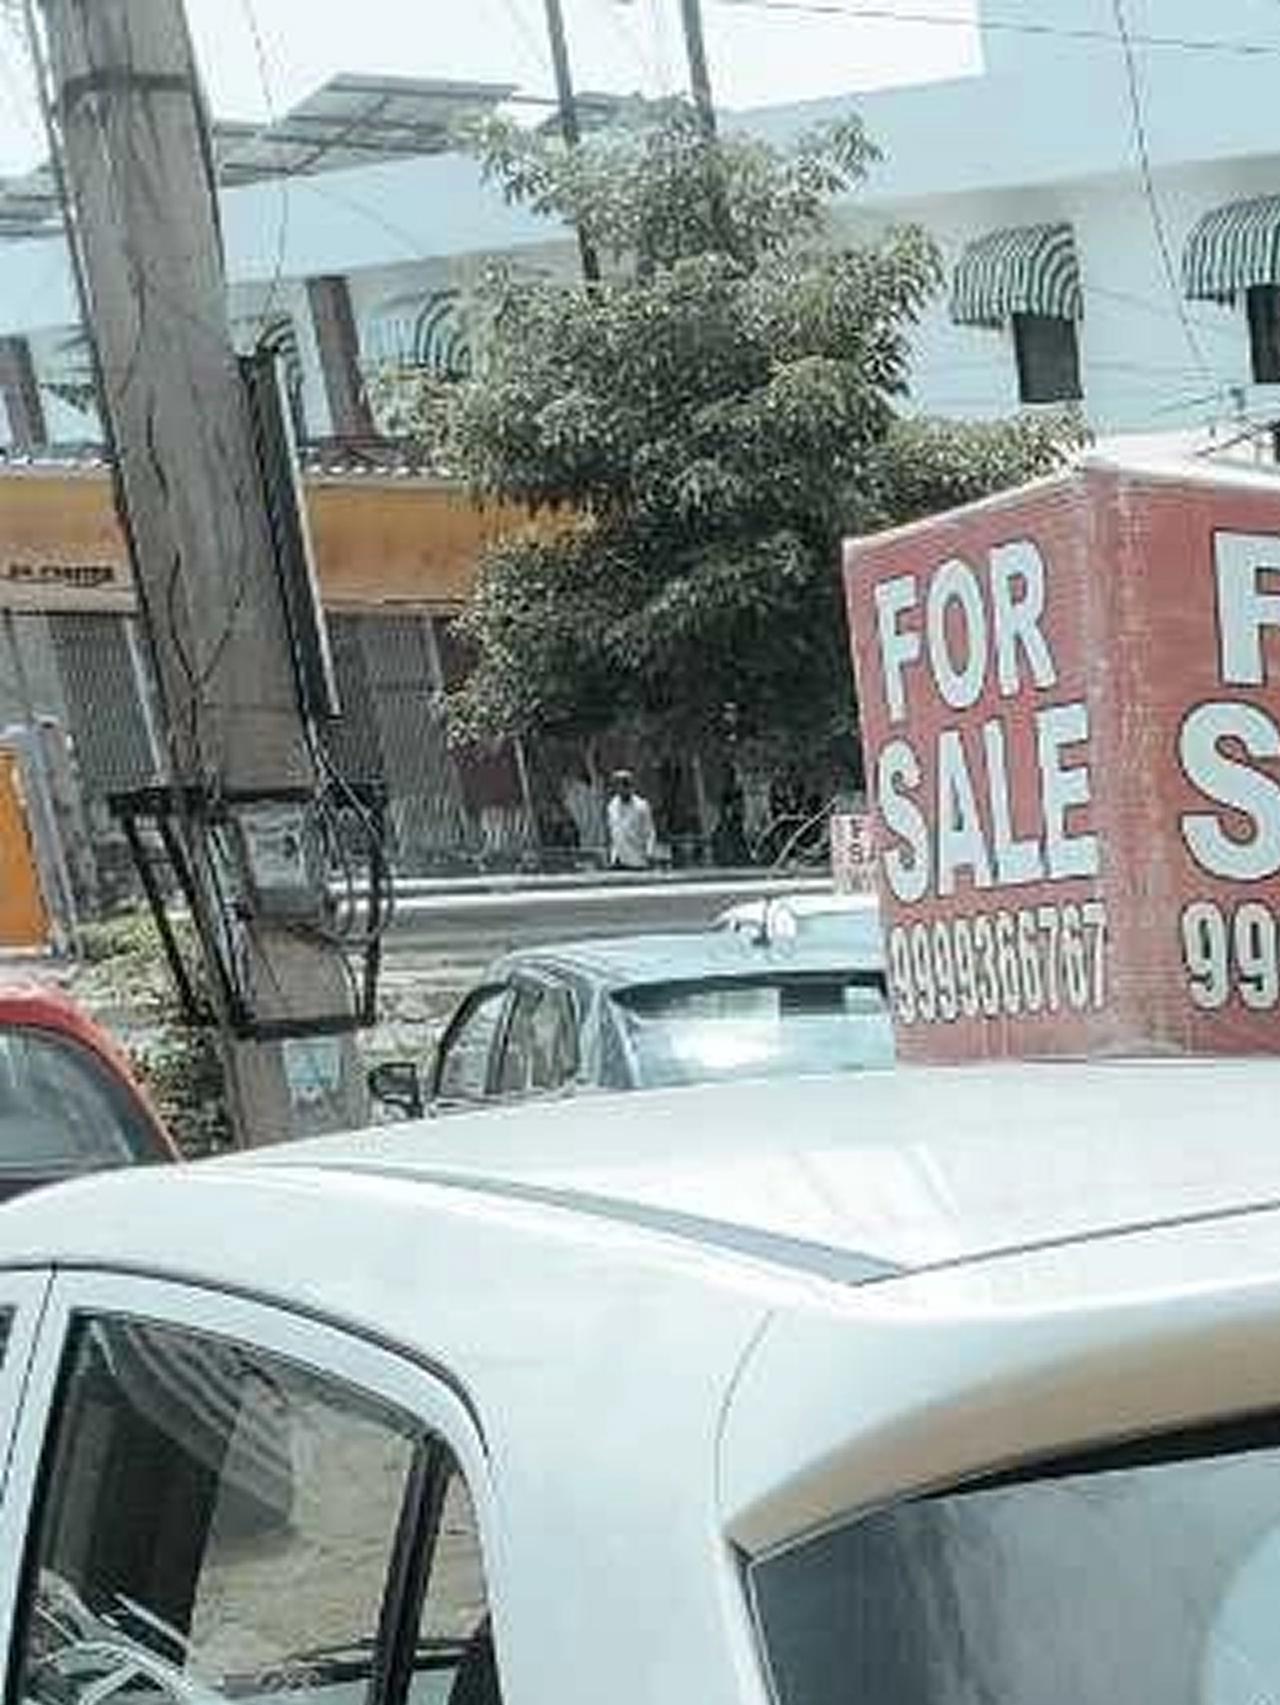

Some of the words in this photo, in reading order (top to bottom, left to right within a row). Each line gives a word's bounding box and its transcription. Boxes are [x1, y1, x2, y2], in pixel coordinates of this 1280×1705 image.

[873, 539, 1058, 722] FOR
[878, 703, 1099, 904] SALE
[890, 902, 1107, 1025] 9999366767
